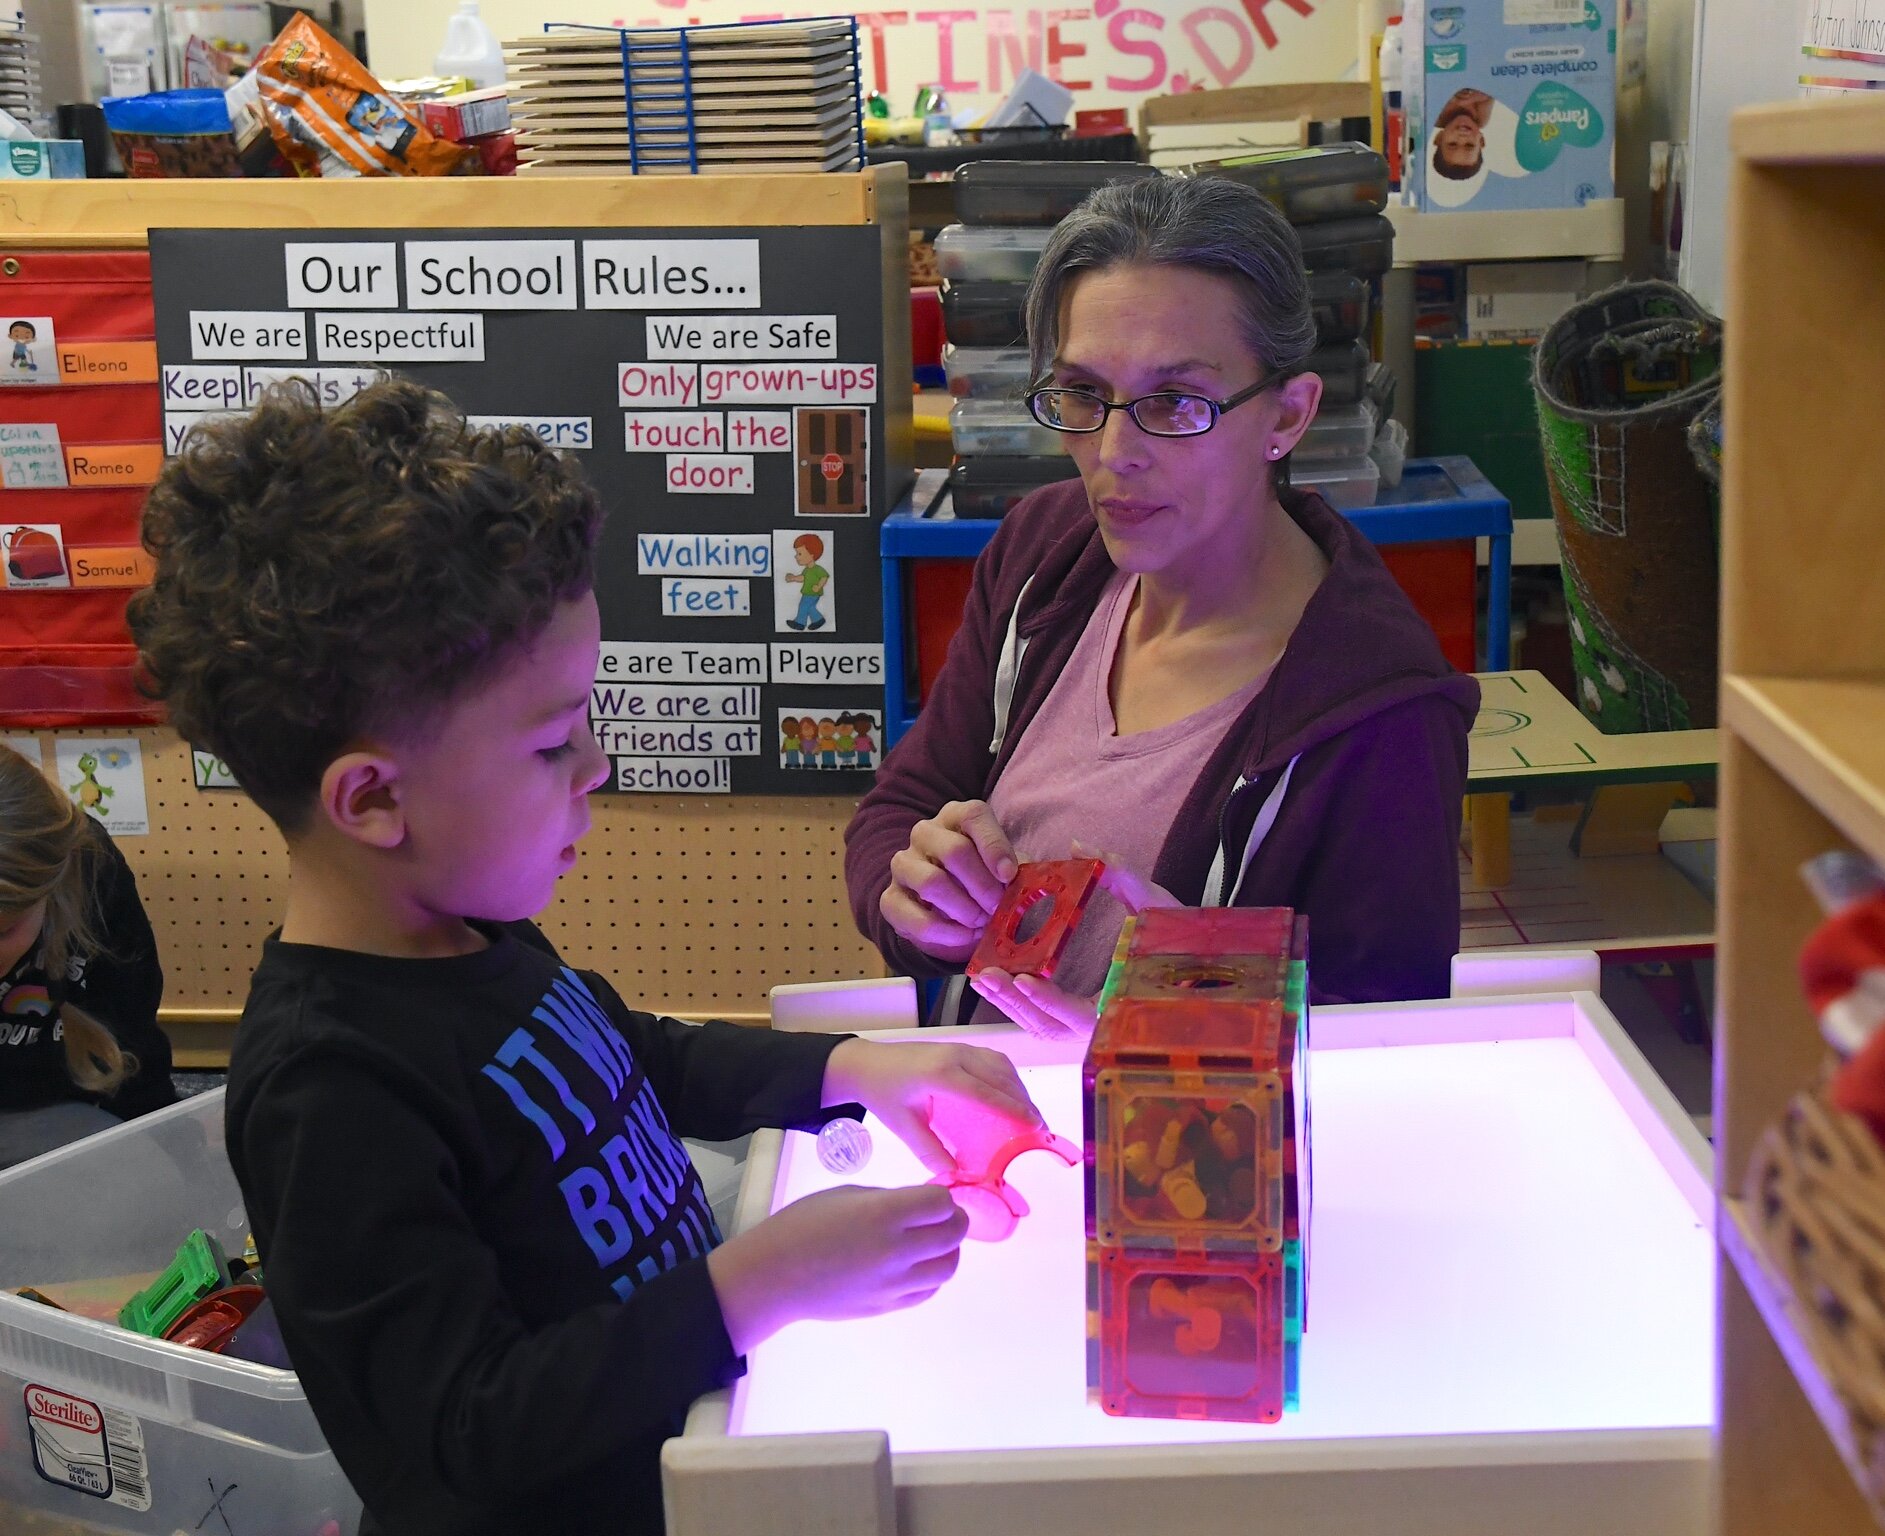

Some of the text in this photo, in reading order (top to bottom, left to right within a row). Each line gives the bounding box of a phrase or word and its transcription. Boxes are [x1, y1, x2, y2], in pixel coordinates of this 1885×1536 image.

[1491, 61, 1598, 78] complete clean
[1525, 108, 1589, 130] Pampers
[301, 255, 747, 295] Our School Rules...
[198, 322, 476, 354] We are Respectful
[653, 322, 832, 349] We are Safe
[63, 354, 128, 373] Elleona
[165, 371, 239, 407] Keep
[621, 365, 875, 405] Only grown-ups
[629, 416, 788, 447] touch the
[73, 457, 135, 476] Romeo
[669, 457, 752, 488] door.
[823, 461, 842, 472] STOP
[77, 559, 139, 577] Samuel
[640, 538, 770, 574] Walking
[668, 582, 748, 613] feet.
[602, 649, 880, 679] e are Team Players
[592, 687, 757, 717] We are all
[596, 724, 758, 752] friends at
[198, 758, 231, 785] yo
[621, 759, 729, 788] school!
[480, 965, 634, 1163] IT WA
[558, 1076, 691, 1270] BROK
[35, 1392, 93, 1427] Sterilite
